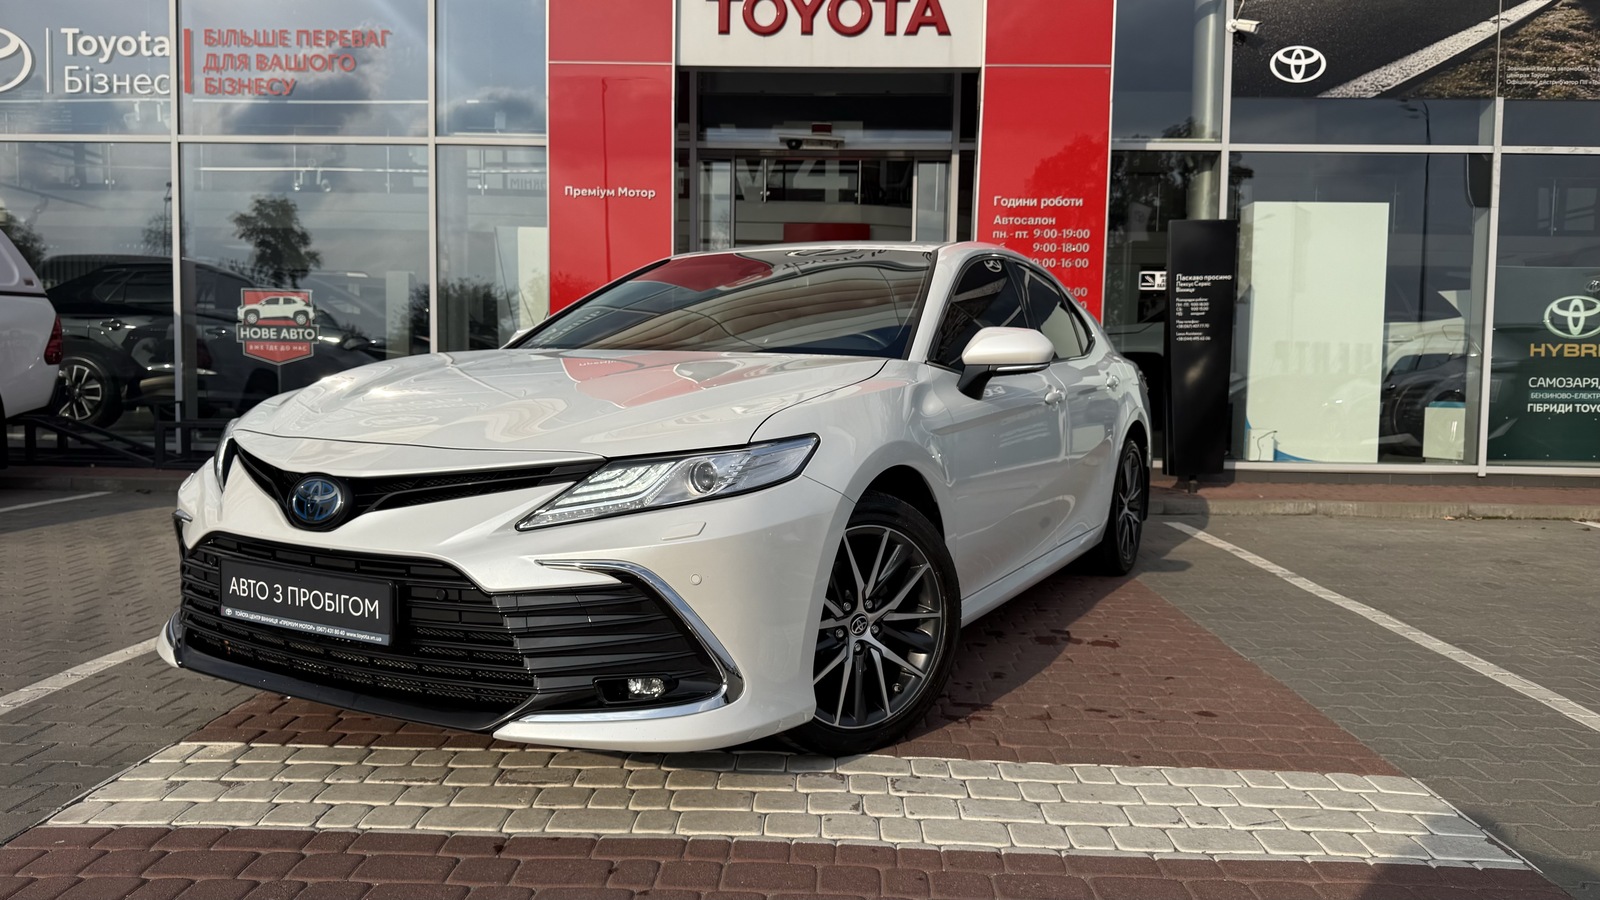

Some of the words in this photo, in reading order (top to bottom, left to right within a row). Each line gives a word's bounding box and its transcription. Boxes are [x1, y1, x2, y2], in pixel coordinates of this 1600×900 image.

[706, 0, 952, 37] TOYOTA
[61, 28, 170, 63] Toyota
[203, 29, 289, 46] БІЛЬШЕ
[295, 29, 391, 48] ПЕРЕВАГ
[202, 53, 249, 74] ДЛЯ
[255, 53, 357, 72] ВАШОГО
[64, 65, 170, 94] Бізнес
[204, 77, 295, 96] БІЗНЕСУ
[564, 185, 615, 199] Преміум
[618, 186, 656, 200] Мотор
[993, 196, 1037, 208] Години
[1040, 196, 1083, 209] роботи
[993, 215, 1056, 225] Автосалон
[240, 327, 277, 339] НОВЕ
[280, 328, 315, 340] АВТО
[1528, 377, 1600, 389] САМОЗАРЯ
[1527, 403, 1573, 414] ГІБРИДИ
[229, 576, 269, 600] АВТО
[273, 584, 283, 603] З
[287, 586, 380, 619] ПРОБІГОМ
